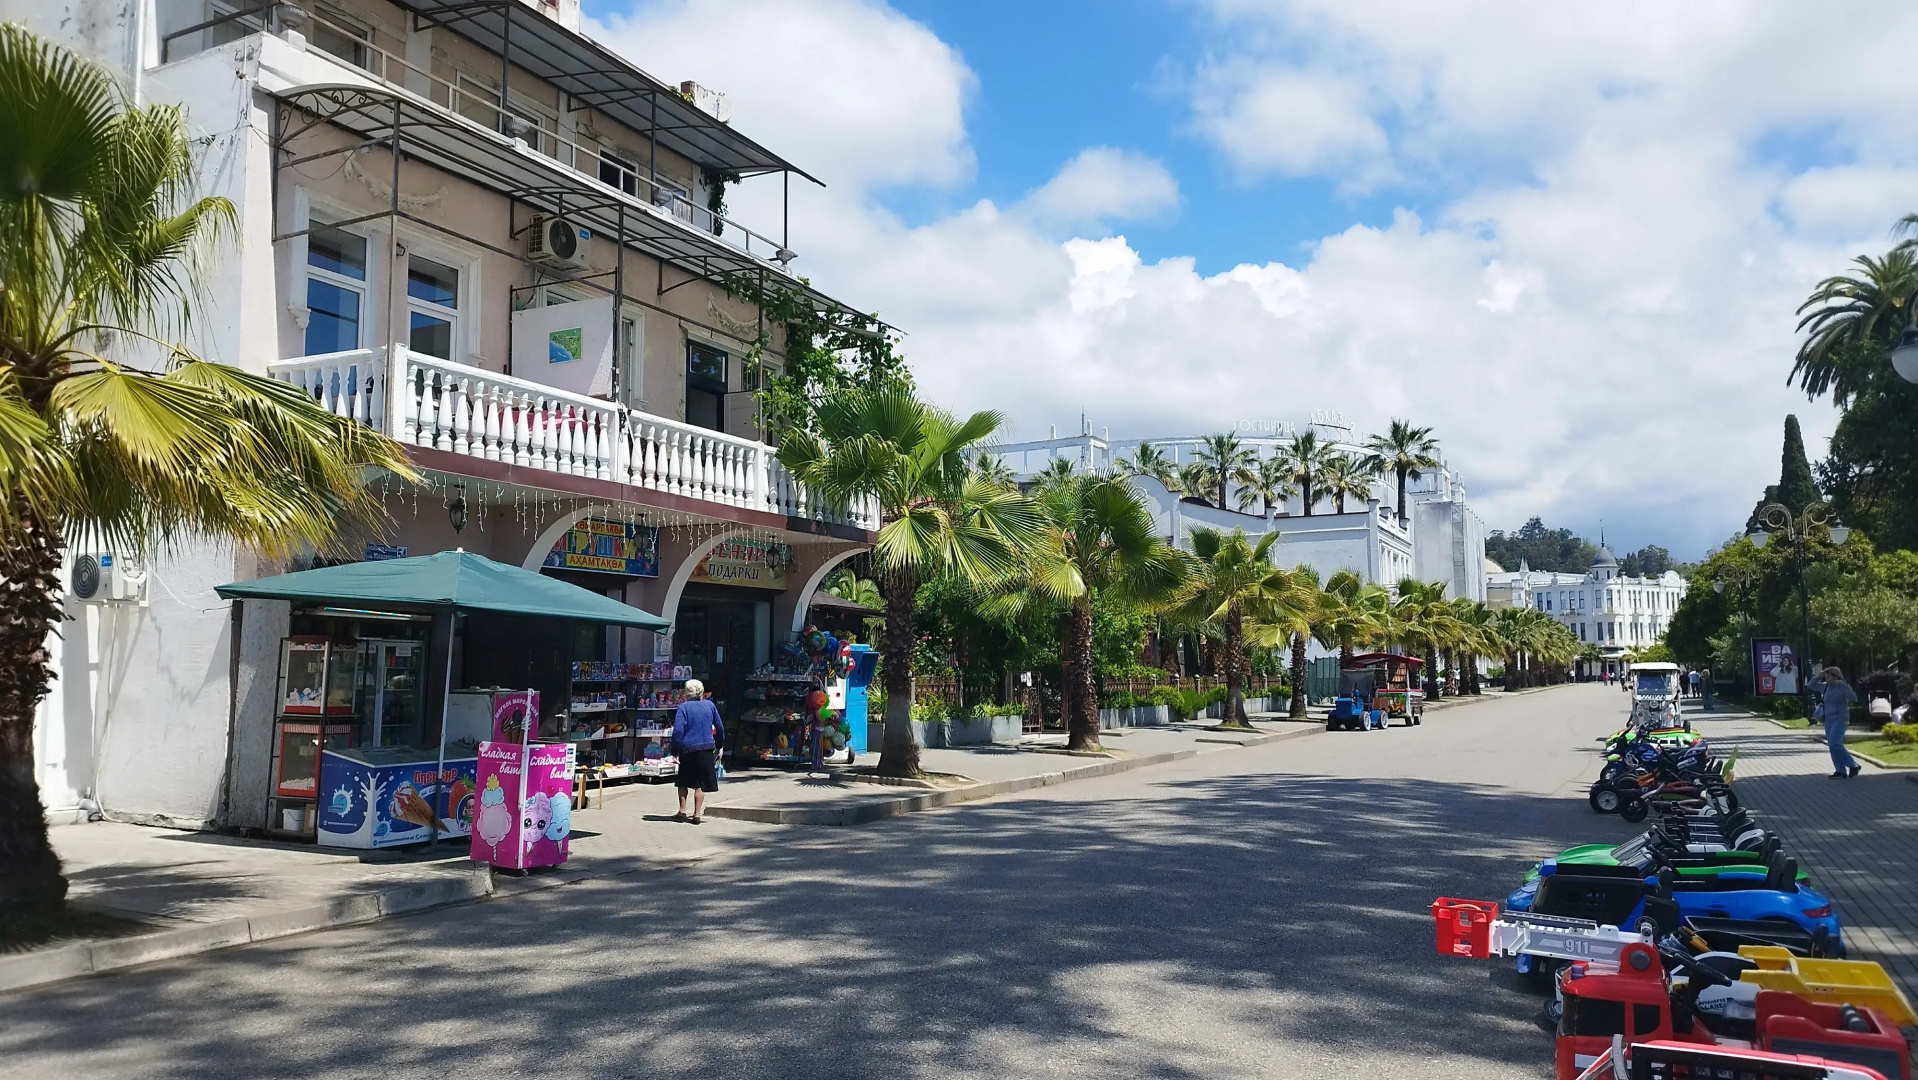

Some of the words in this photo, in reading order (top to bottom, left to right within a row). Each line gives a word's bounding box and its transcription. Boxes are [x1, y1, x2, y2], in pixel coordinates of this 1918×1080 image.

[1233, 419, 1296, 434] ГОСТИНИЦА
[1310, 408, 1356, 432] АБХАЗИЯ
[554, 530, 637, 560] ИГРУШКИ
[707, 563, 760, 581] ПОДАРКИ
[1565, 939, 1589, 955] 911
